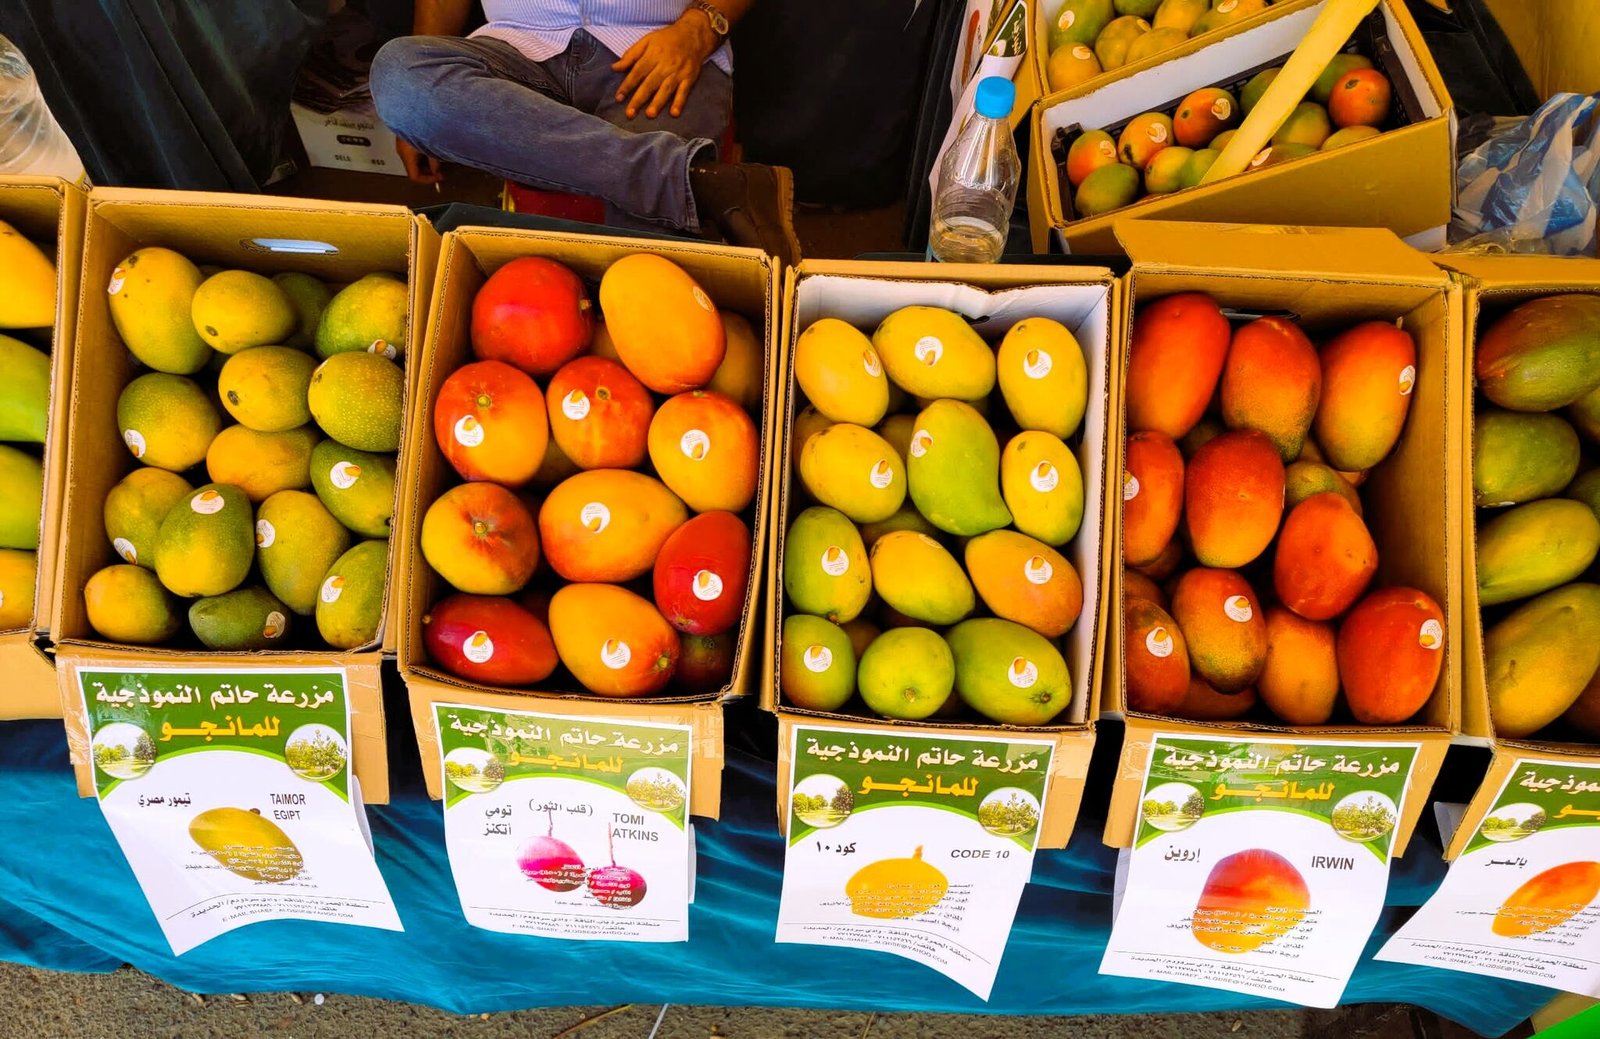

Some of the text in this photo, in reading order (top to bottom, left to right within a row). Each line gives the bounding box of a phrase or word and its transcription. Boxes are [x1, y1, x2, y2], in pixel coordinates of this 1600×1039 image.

[92, 682, 334, 710] مزرعة حاتم النموذجية
[160, 715, 280, 741] للمانجو
[448, 714, 679, 755] مزرعة حاتم النموذجية
[508, 751, 624, 773] للمانجو
[806, 738, 1038, 773] مزرعة حاتم النموذجية
[1164, 749, 1399, 778] مزرعة حاتم النموذجية
[858, 774, 978, 798] للمانجو
[1211, 780, 1335, 802] للمانجو
[139, 793, 191, 807] تيمور مصري
[270, 794, 306, 805] TAIMOR
[274, 810, 300, 820] EGIPT
[485, 804, 512, 819] تومي
[613, 813, 644, 825] TOMI
[612, 828, 658, 841] ATKINS
[816, 841, 856, 856] كود ١٠
[951, 849, 1010, 858] CODE 10
[1164, 845, 1200, 862] إروين
[1312, 856, 1354, 870] IRWIN
